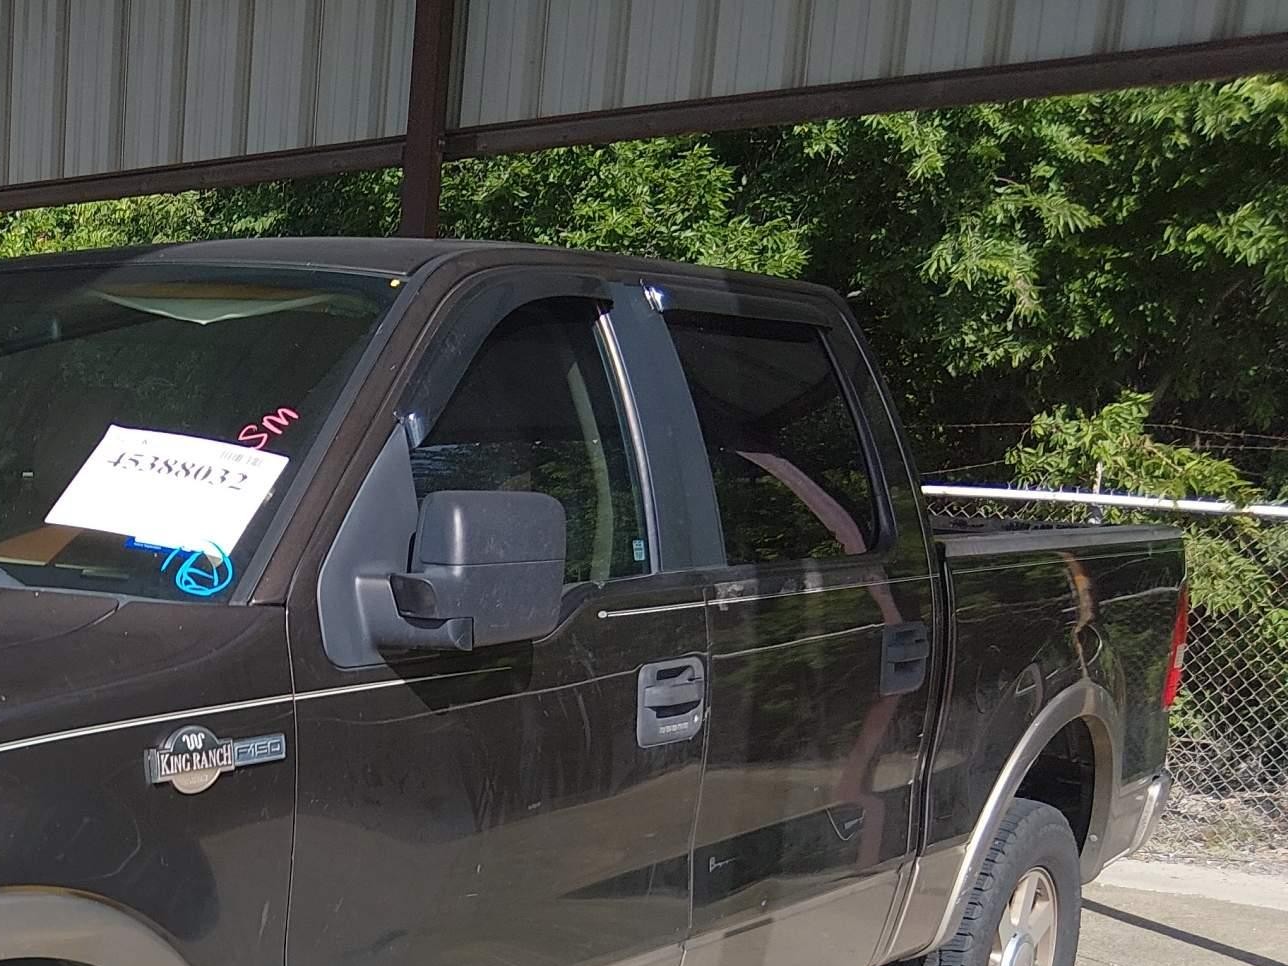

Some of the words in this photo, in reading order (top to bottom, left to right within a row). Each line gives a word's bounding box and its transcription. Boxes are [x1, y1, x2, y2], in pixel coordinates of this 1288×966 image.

[238, 407, 300, 450] SM
[107, 450, 249, 490] 45388032
[160, 752, 191, 776] KING
[192, 744, 232, 770] RANCH
